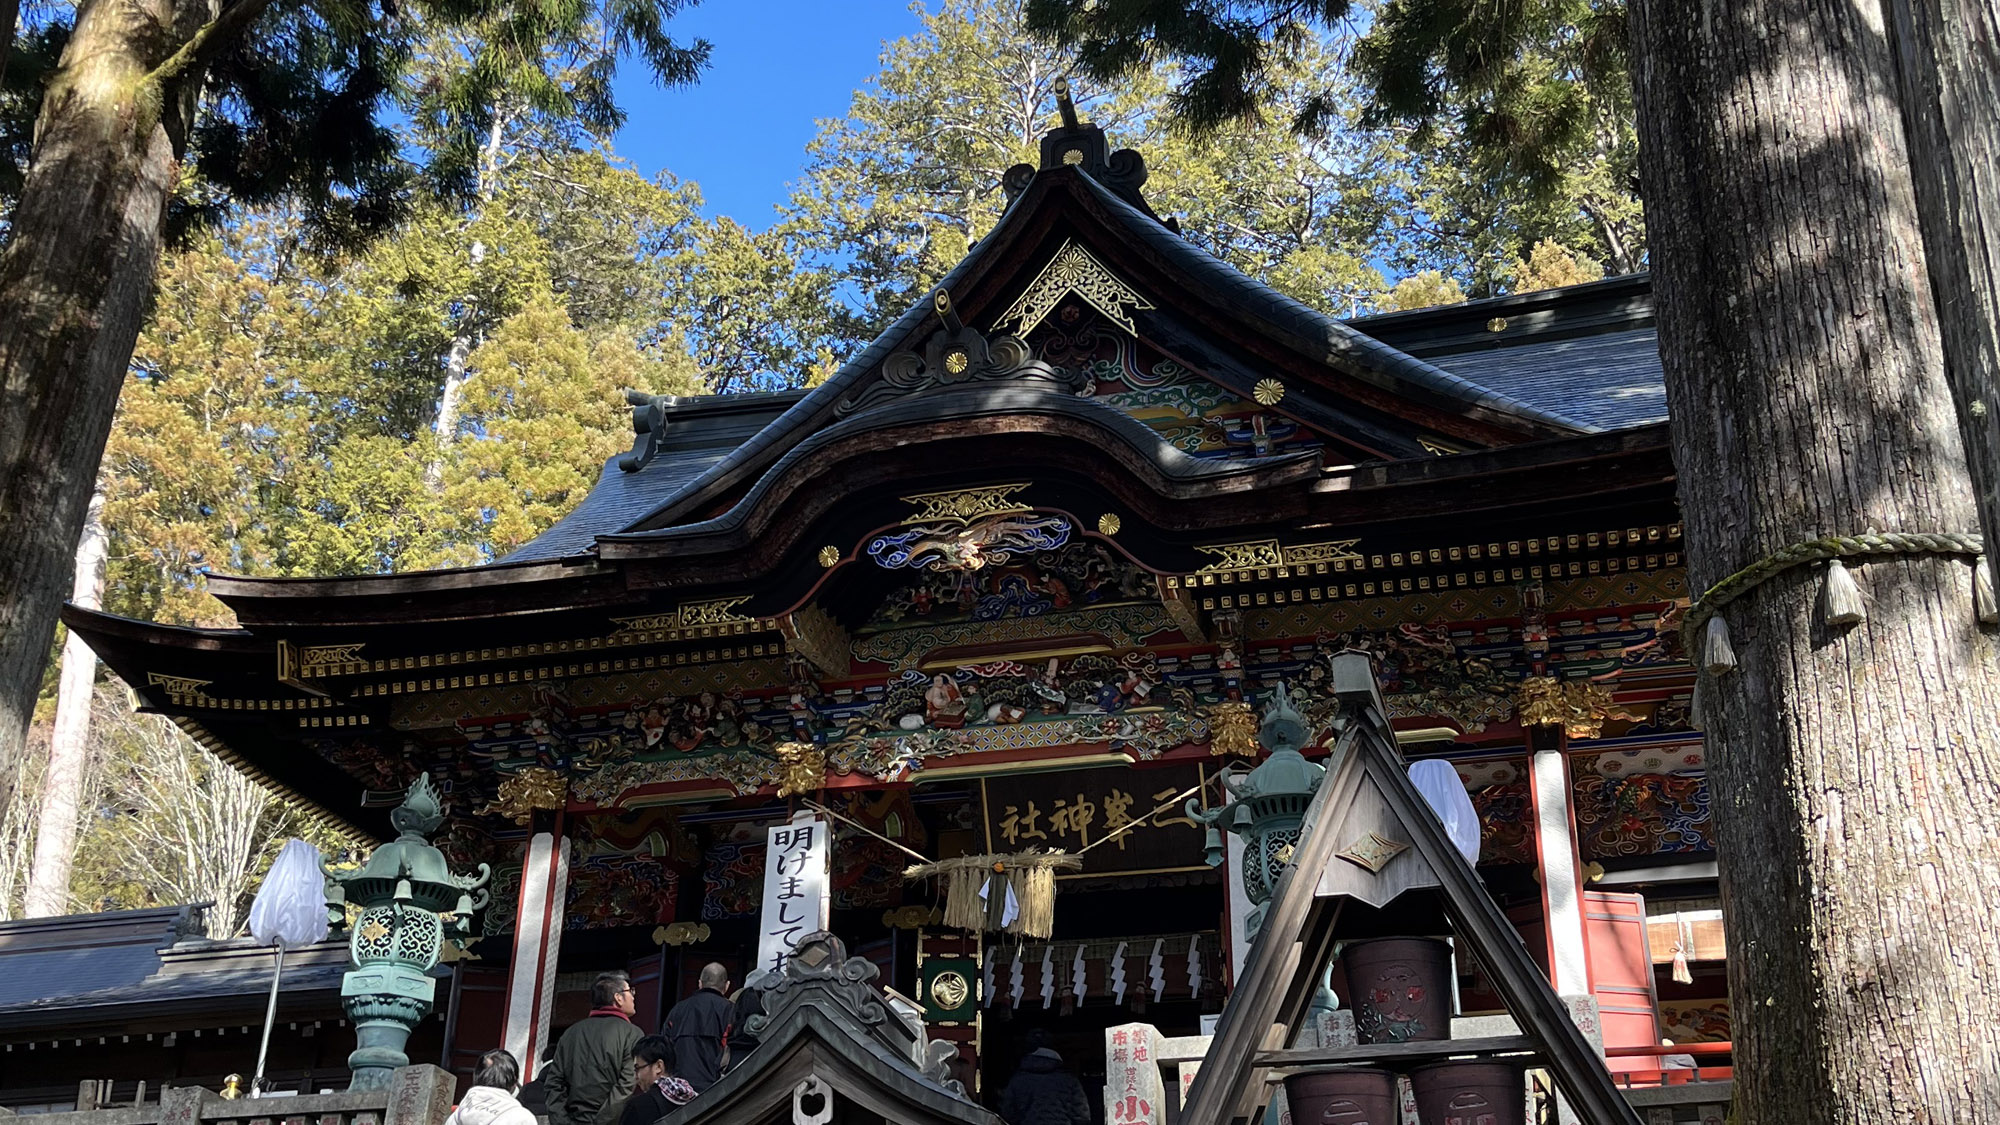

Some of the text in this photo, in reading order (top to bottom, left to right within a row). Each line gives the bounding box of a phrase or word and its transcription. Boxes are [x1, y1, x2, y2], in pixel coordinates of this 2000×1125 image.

[1000, 787, 1197, 850] 三峯神社
[1115, 1096, 1150, 1125] 小
